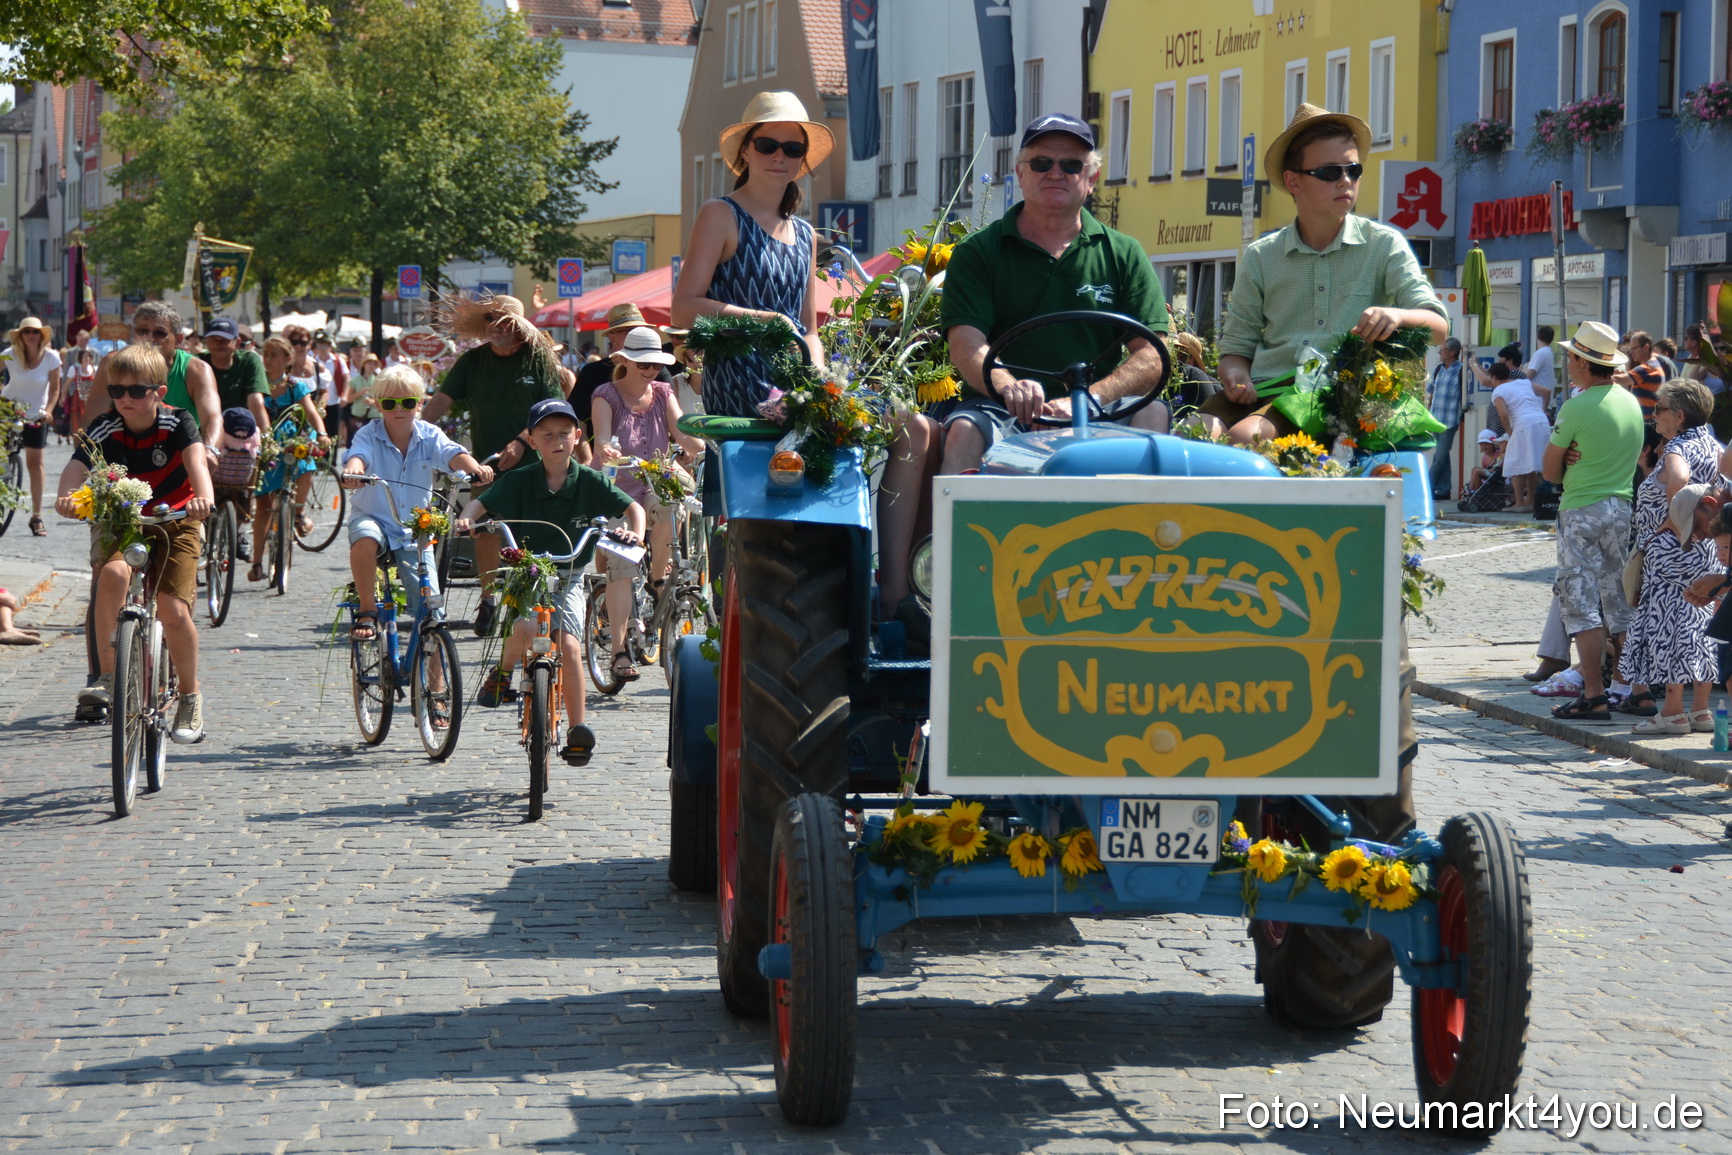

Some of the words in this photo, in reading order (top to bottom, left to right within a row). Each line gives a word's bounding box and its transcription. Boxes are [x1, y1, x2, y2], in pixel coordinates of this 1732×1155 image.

[1165, 29, 1204, 70] HOTEL
[1215, 22, 1261, 57] Lehmeier
[1157, 218, 1213, 245] Restaurant
[1489, 266, 1514, 279] APOTHEKE
[1568, 260, 1595, 274] APOTHEKE
[401, 287, 419, 295] TAXI
[560, 286, 580, 295] TAXI
[1052, 554, 1289, 629] EXPRESS
[1058, 658, 1293, 715] NEUMARKT
[1106, 816, 1114, 825] D
[1123, 801, 1160, 829] NM
[1108, 831, 1144, 859] GA
[1156, 832, 1209, 860] 824
